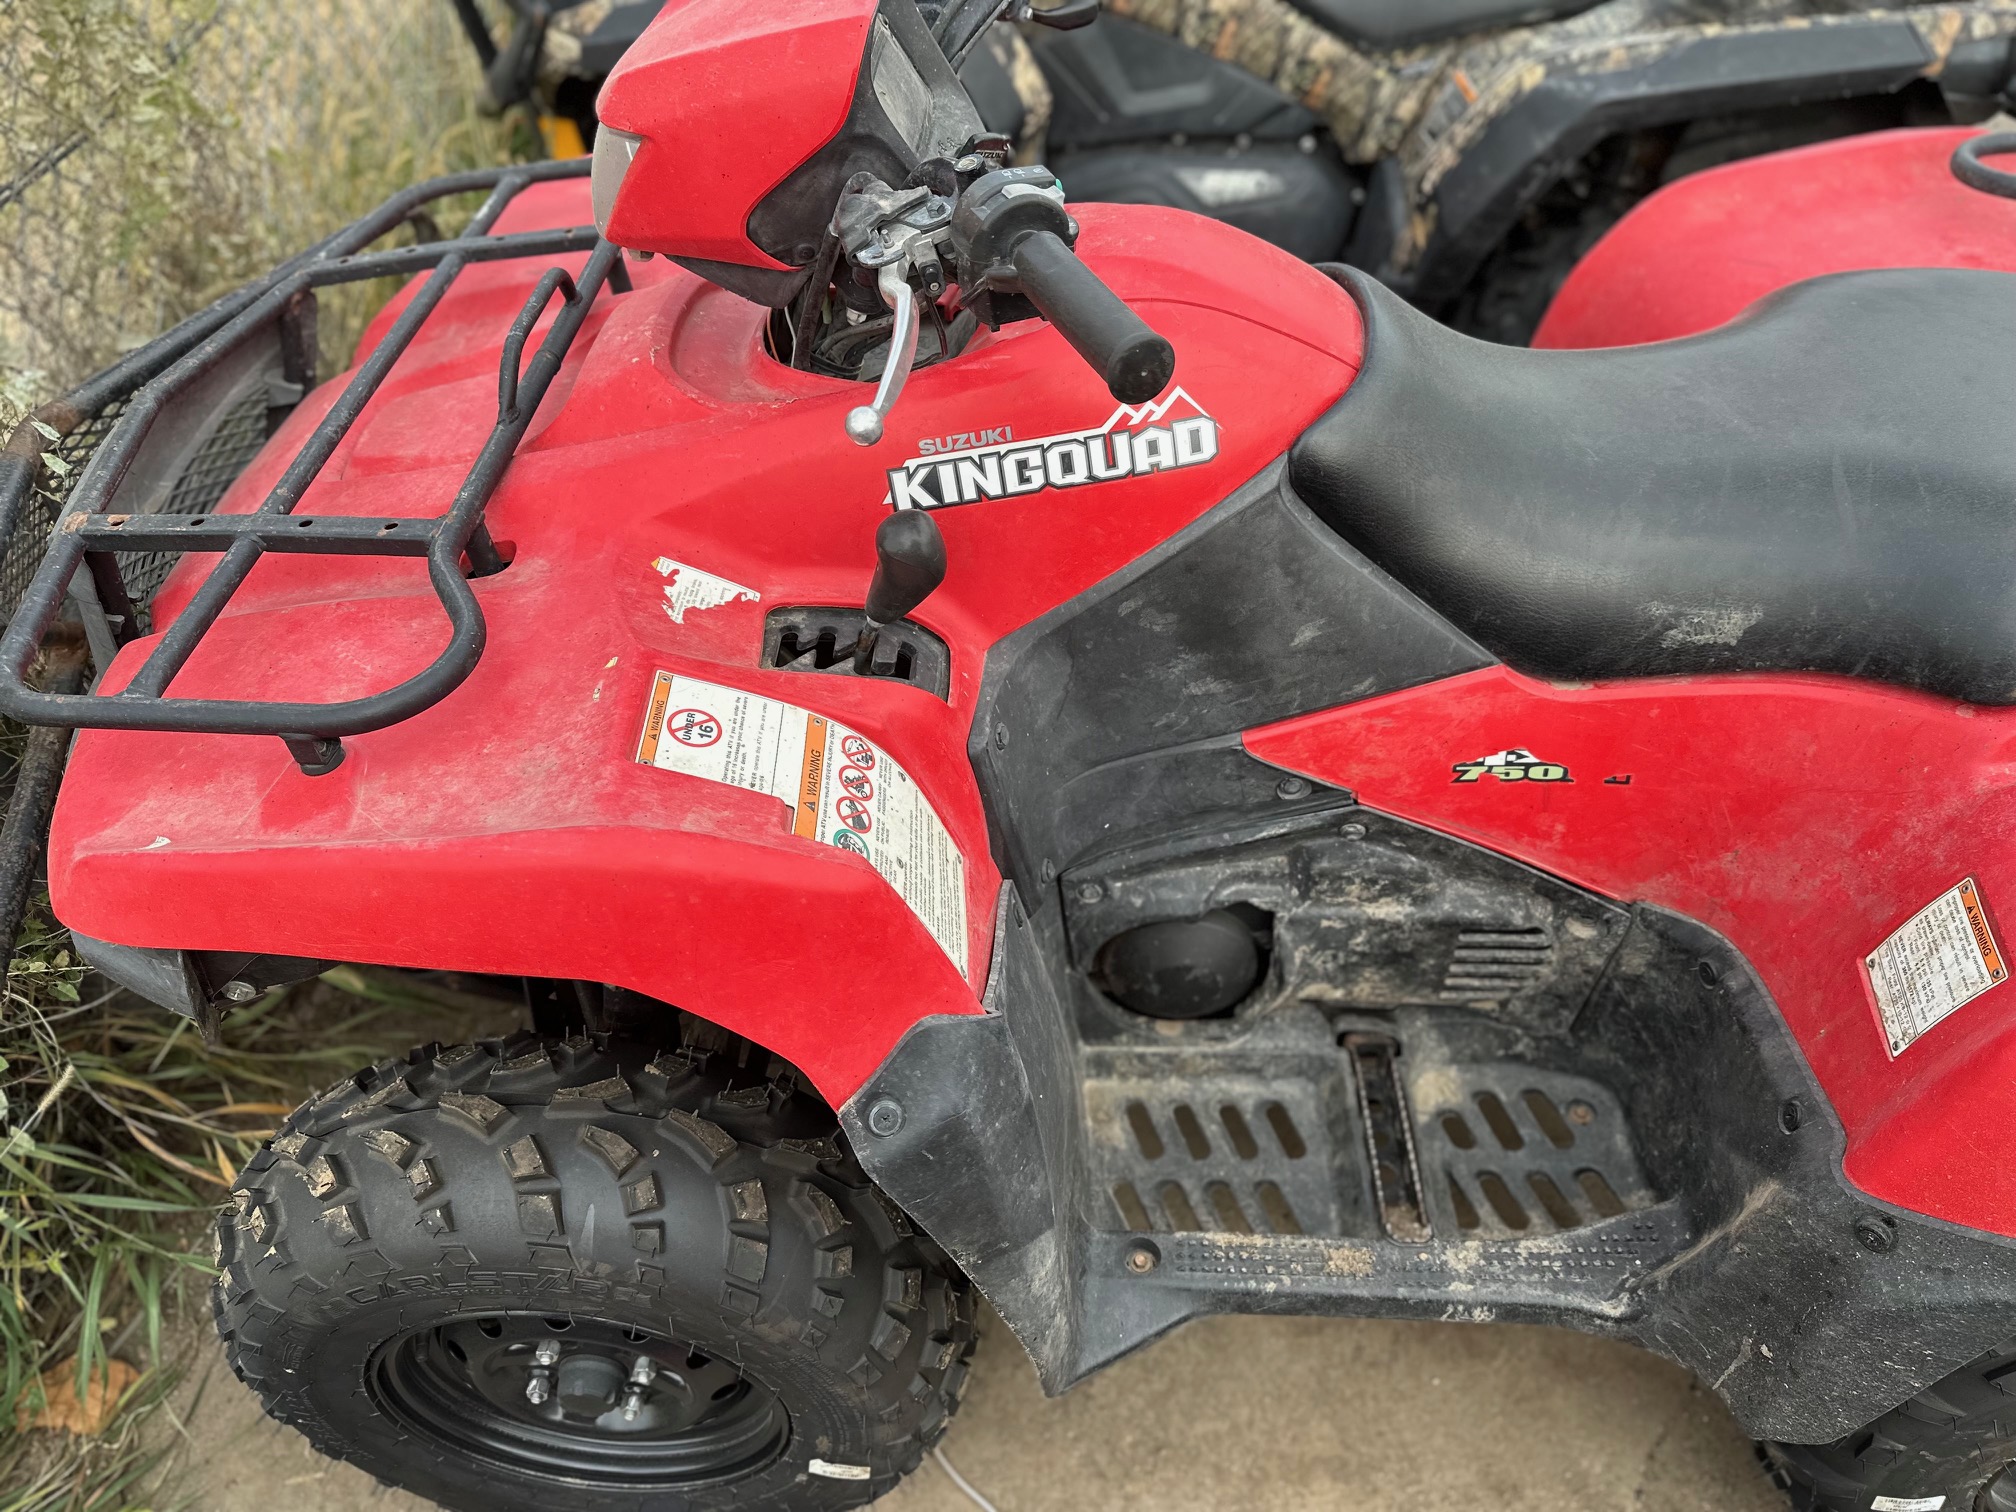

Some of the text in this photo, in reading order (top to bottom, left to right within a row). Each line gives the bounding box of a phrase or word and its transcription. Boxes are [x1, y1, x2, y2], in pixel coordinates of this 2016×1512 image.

[918, 425, 1013, 456] SUZUKI
[889, 418, 1217, 511] KINGQUAD
[651, 699, 664, 731] WARNING
[683, 712, 696, 741] UNDER
[698, 724, 714, 740] 16
[722, 760, 731, 782] Operating
[807, 748, 821, 799] WARNING
[1453, 765, 1567, 782] 750
[1898, 935, 1906, 953] NEVER
[1943, 924, 1952, 941] control
[1950, 895, 1961, 916] Improper
[1961, 926, 1972, 947] pressure
[1972, 955, 1986, 984] overloading
[1970, 913, 1992, 957] WARNING
